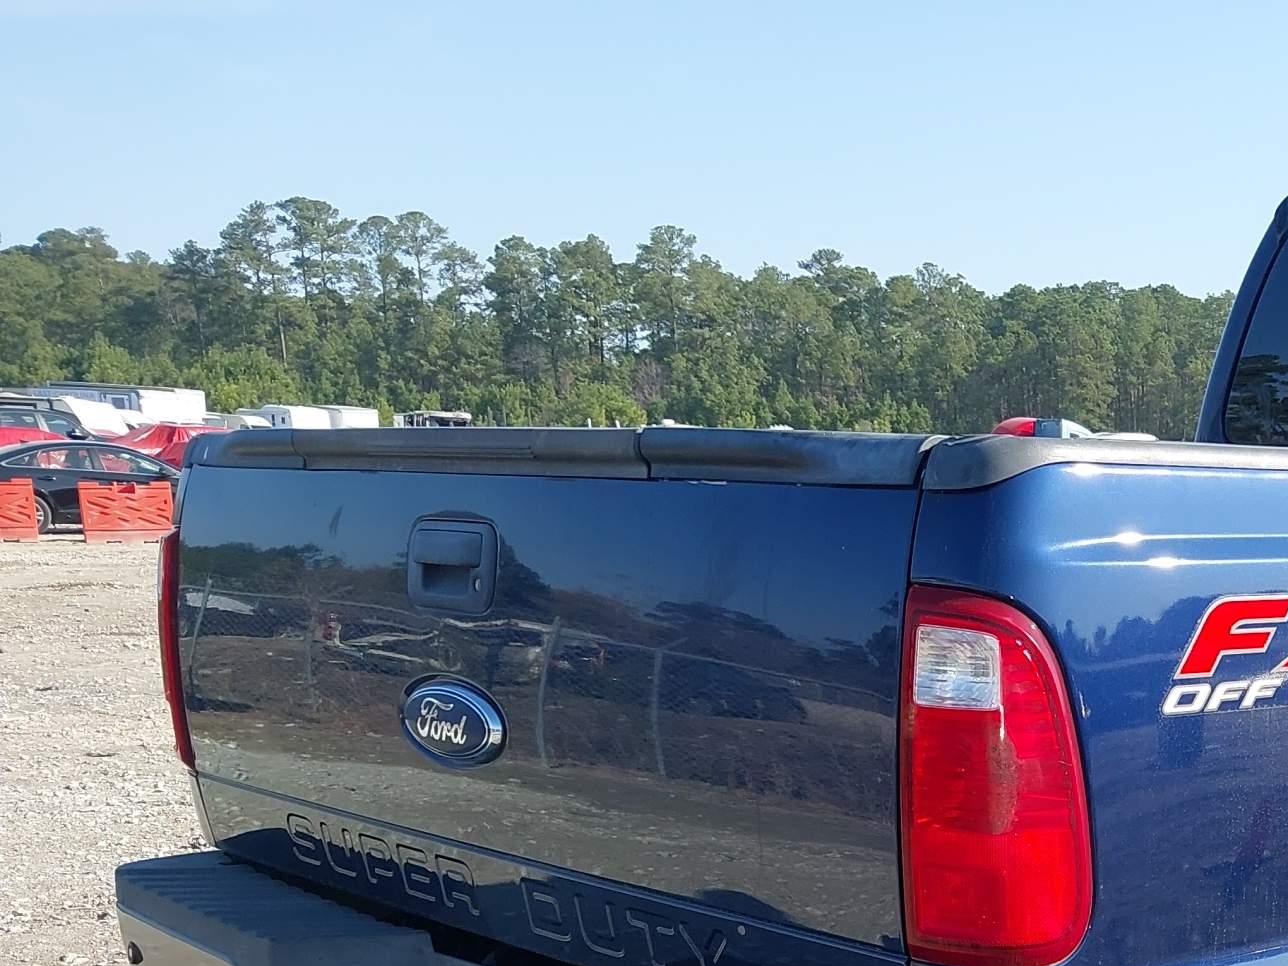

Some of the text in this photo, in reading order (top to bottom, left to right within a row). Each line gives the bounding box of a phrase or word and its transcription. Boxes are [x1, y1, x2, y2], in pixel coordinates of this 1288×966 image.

[1161, 673, 1286, 716] OFF
[416, 697, 467, 745] Ford
[285, 812, 480, 917] SUPER
